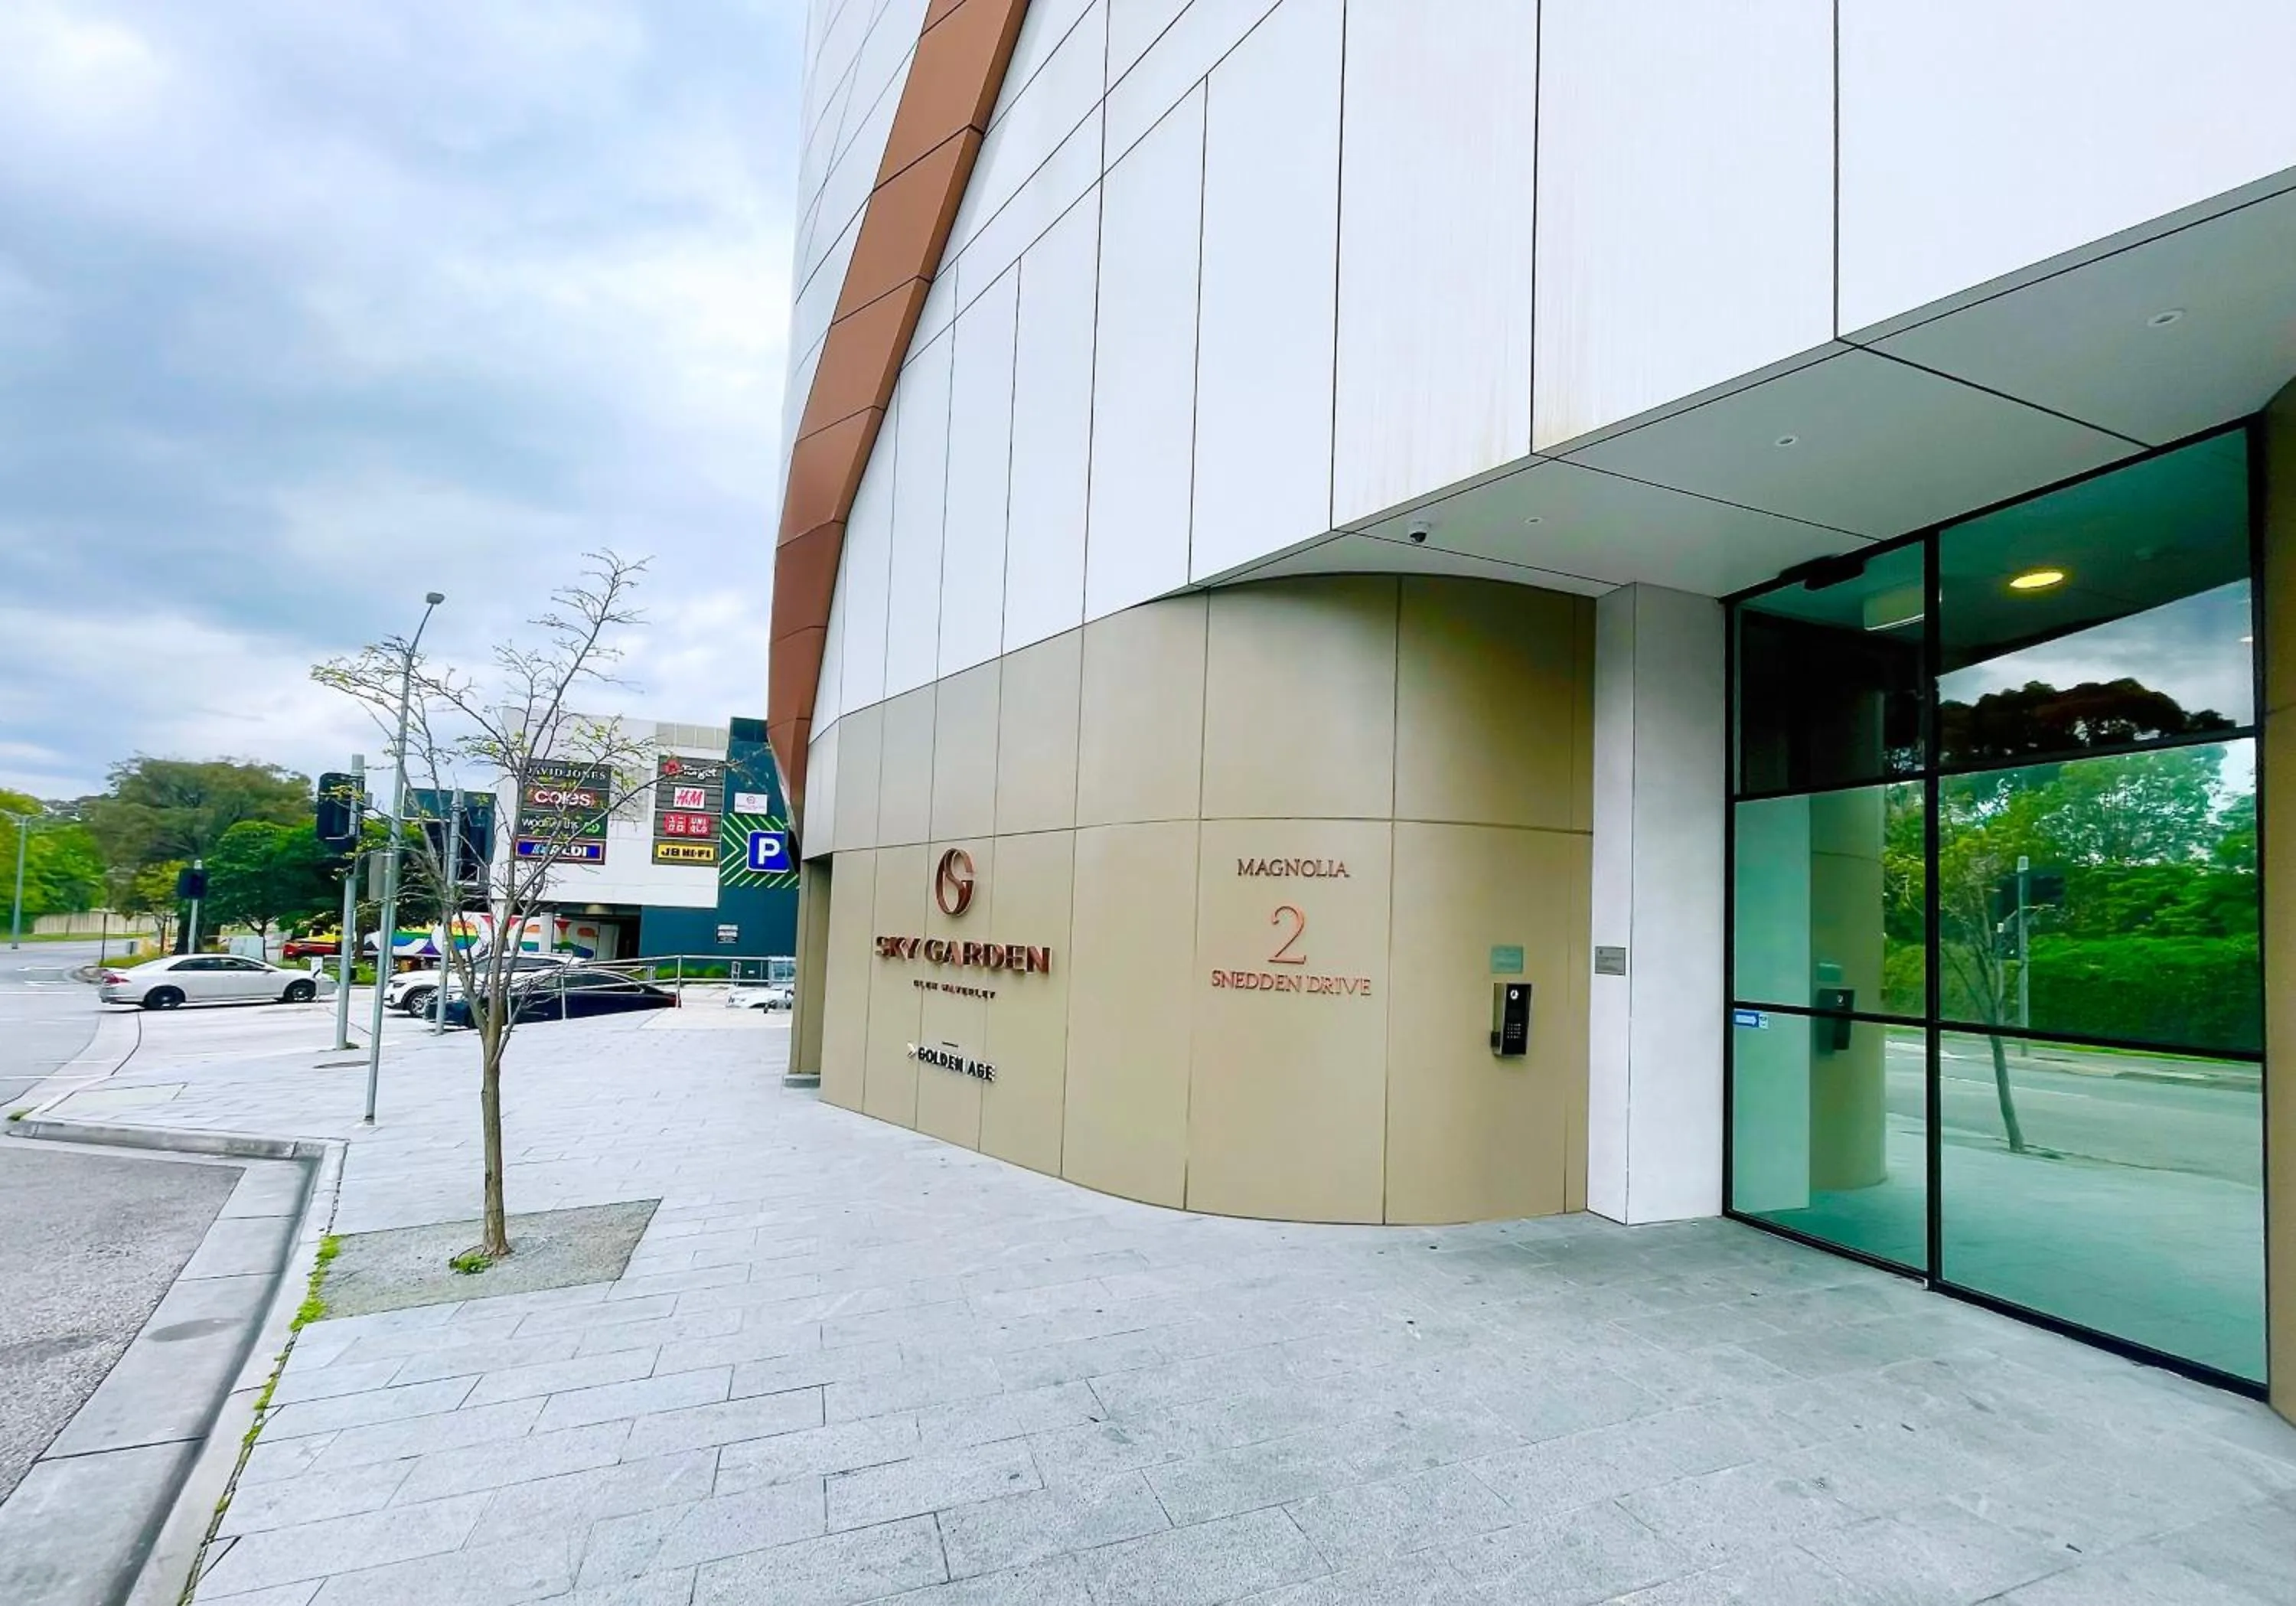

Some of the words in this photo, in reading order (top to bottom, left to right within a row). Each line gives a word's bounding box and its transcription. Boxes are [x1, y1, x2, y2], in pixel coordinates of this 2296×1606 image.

[660, 847, 680, 856] JB
[757, 837, 781, 865] P
[1237, 857, 1351, 878] MAGNOLIA
[1267, 905, 1306, 965] 2
[876, 935, 921, 960] SKY
[923, 938, 1052, 974] GARDEN
[1212, 969, 1303, 994] SNEDDEN
[1306, 974, 1372, 997] DRIVE
[918, 1046, 967, 1073] GOLDEN
[967, 1059, 996, 1082] AGE
